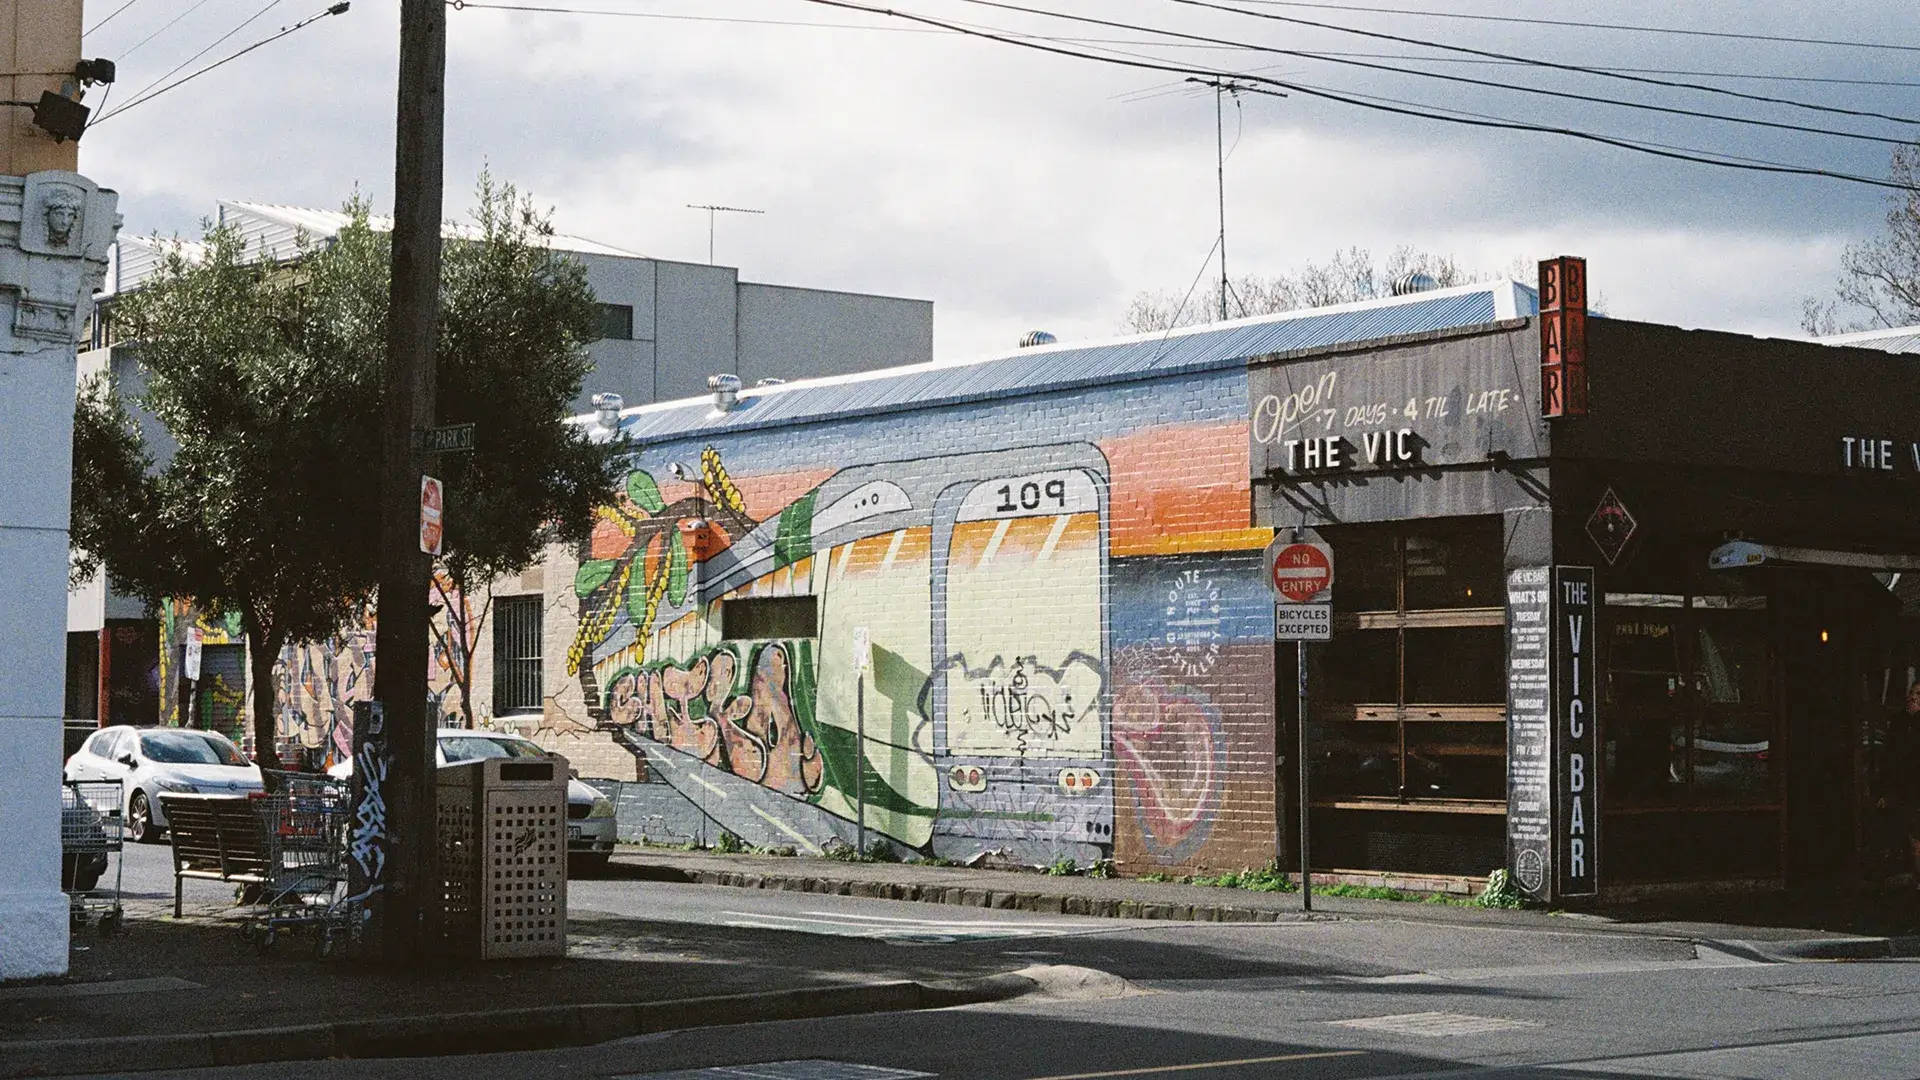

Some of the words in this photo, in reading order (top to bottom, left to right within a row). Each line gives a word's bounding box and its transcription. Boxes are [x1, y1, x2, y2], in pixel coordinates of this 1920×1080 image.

[1543, 264, 1560, 412] BAR
[1253, 370, 1337, 445] Open
[1344, 403, 1387, 428] DAYS
[1403, 399, 1418, 421] 4
[1425, 394, 1449, 419] TIL
[435, 428, 459, 450] PARK
[461, 426, 472, 447] ST
[1284, 435, 1342, 471] THE
[1362, 428, 1413, 464] VIC
[1843, 436, 1893, 470] THE
[996, 479, 1066, 513] 109
[1293, 553, 1310, 565] NO
[1282, 580, 1322, 593] ENTRY
[1510, 590, 1536, 604] WHAT'S
[1563, 581, 1588, 604] THE
[1278, 624, 1328, 634] EXCEPTED
[1279, 610, 1328, 620] BICYCLES
[1568, 614, 1584, 738] VIC
[1570, 753, 1585, 878] BAR
